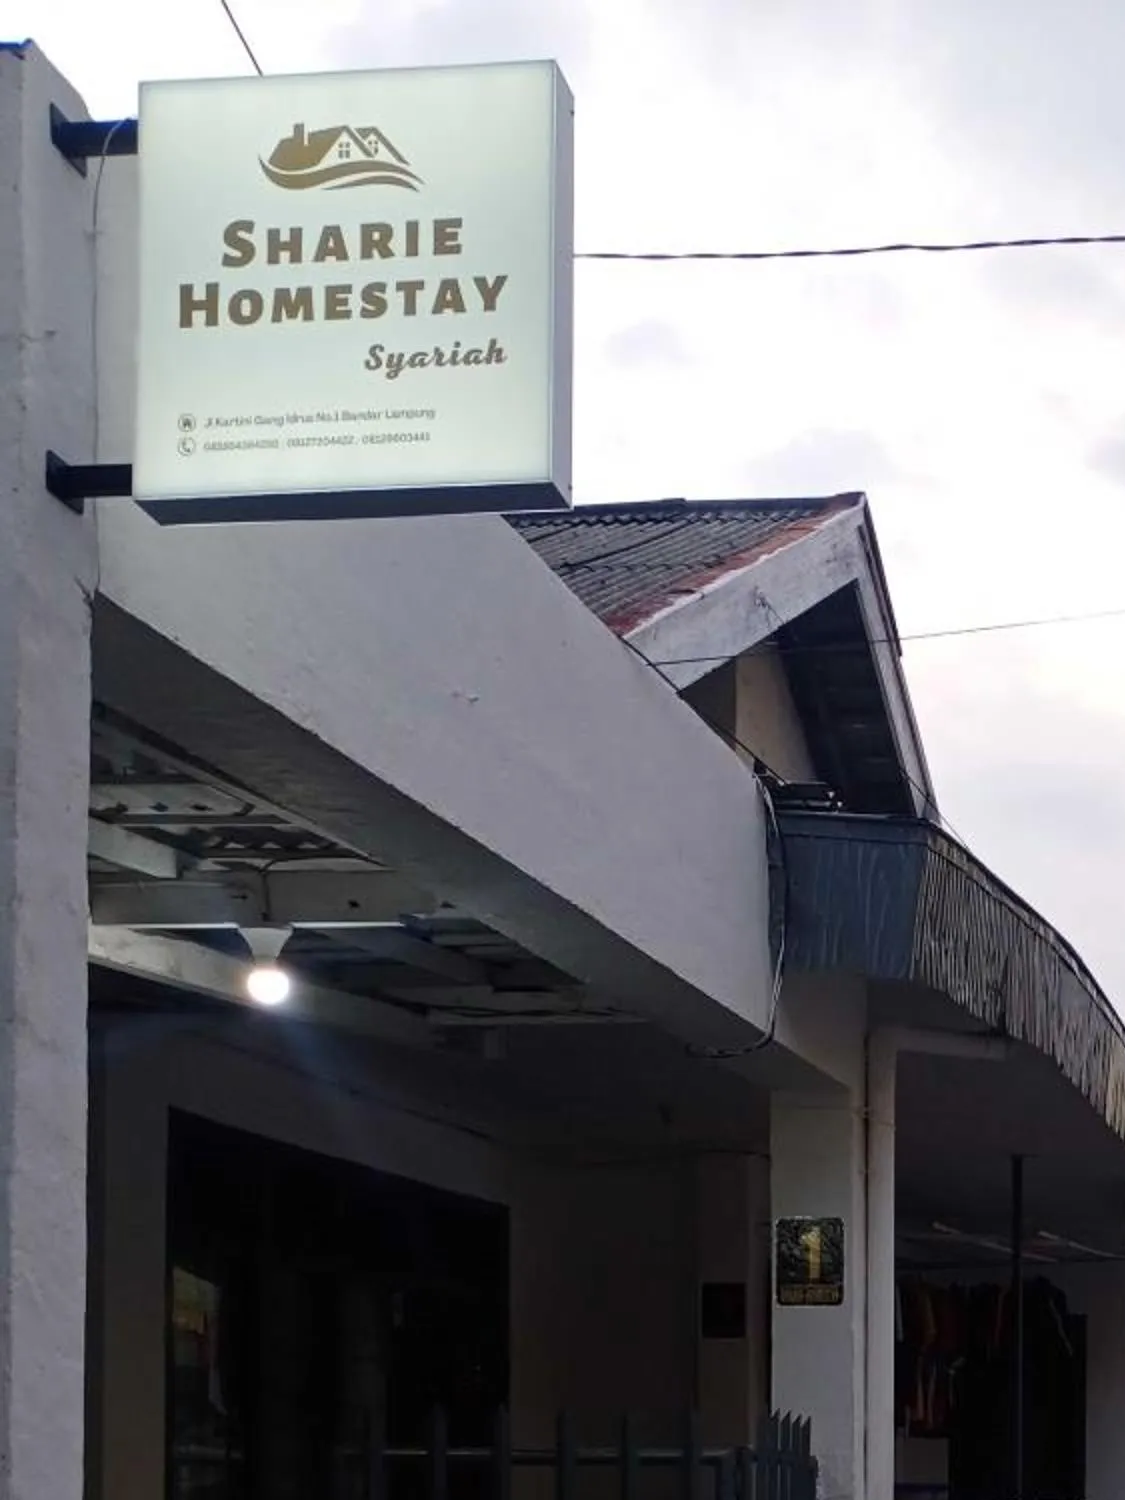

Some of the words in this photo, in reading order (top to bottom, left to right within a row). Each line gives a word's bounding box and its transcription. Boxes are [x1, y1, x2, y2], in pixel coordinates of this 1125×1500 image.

[222, 218, 463, 268] SHARIE
[178, 275, 509, 329] HOMESTAY
[364, 338, 507, 379] Syariah
[802, 1226, 820, 1279] 1
